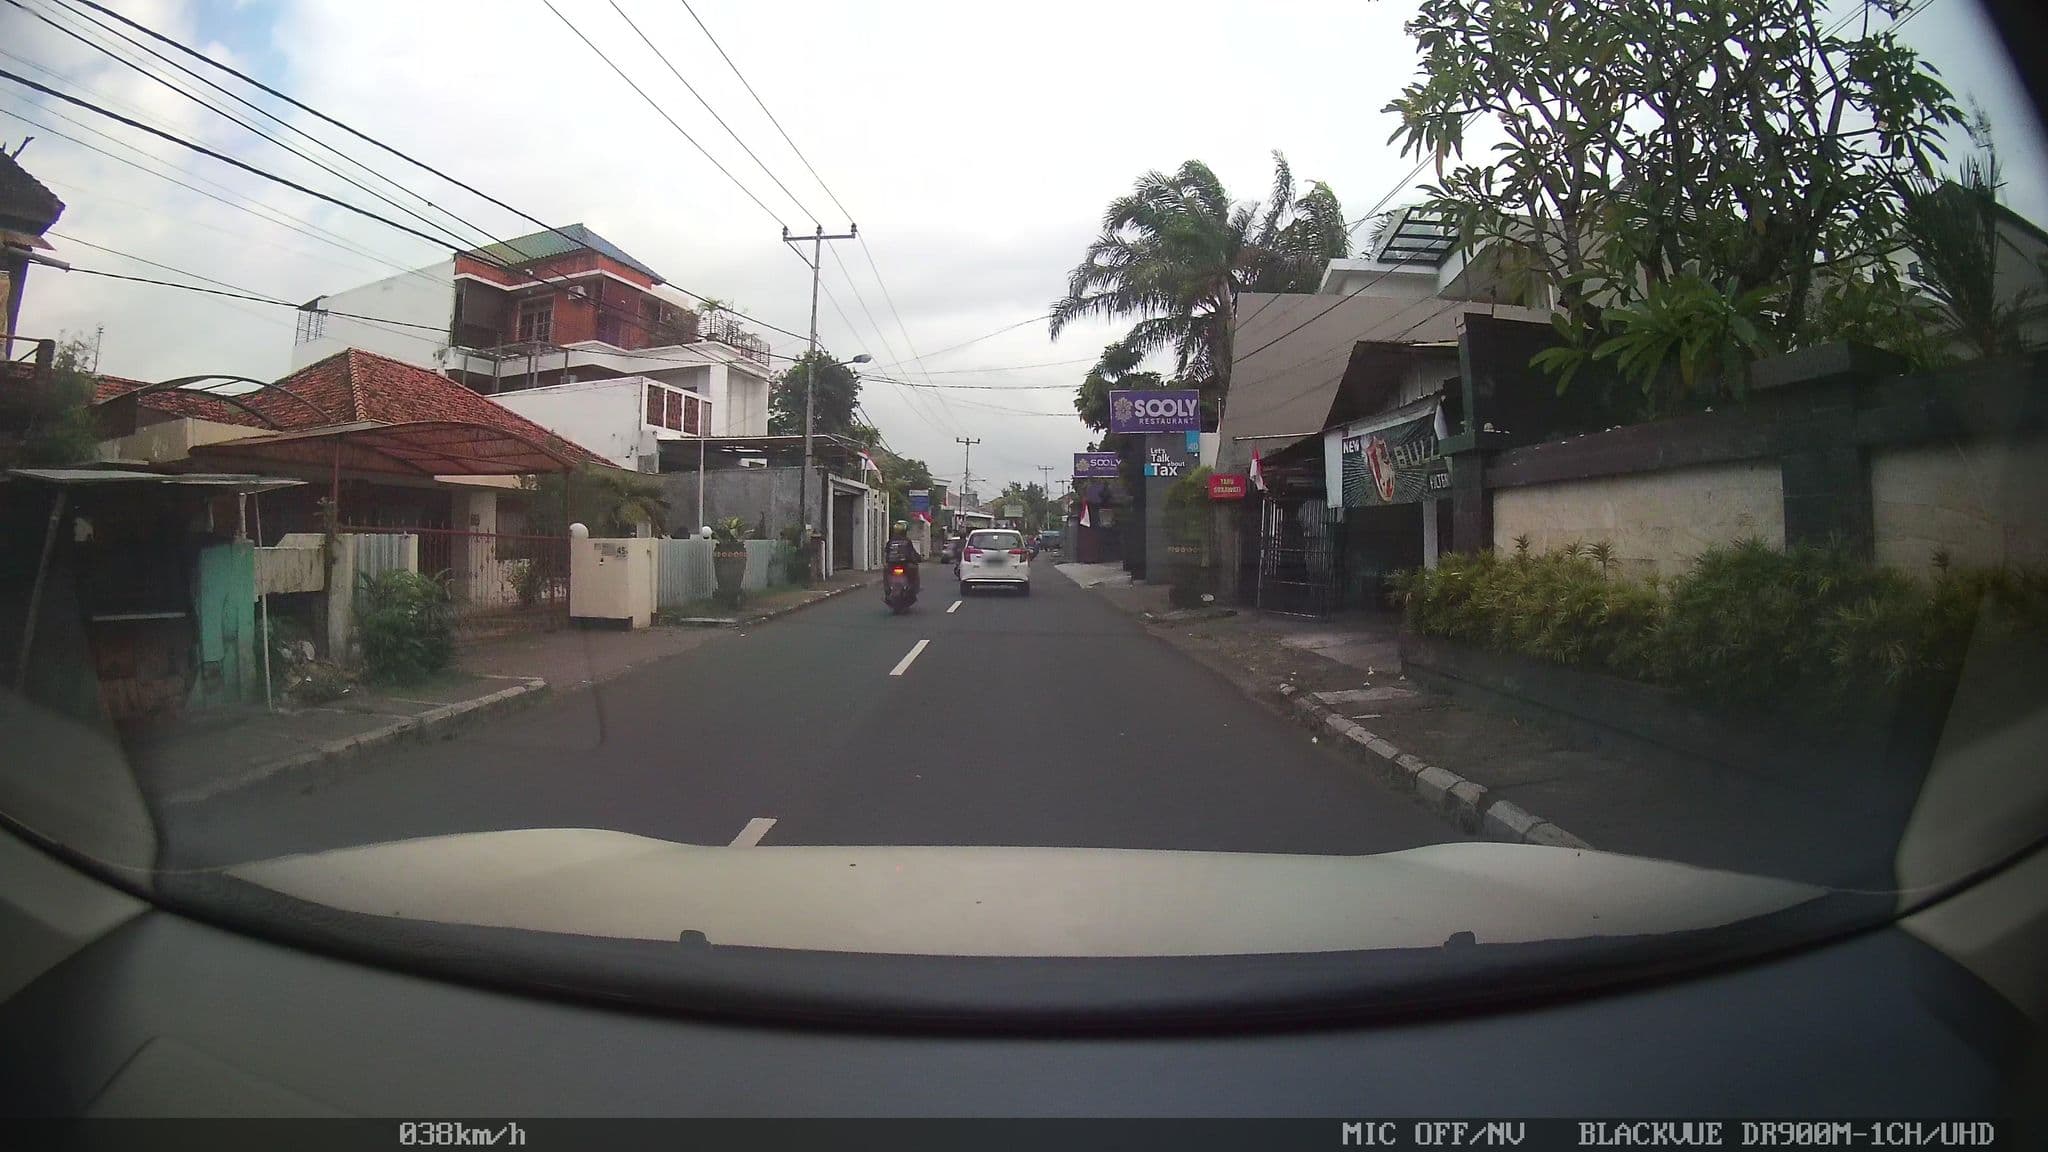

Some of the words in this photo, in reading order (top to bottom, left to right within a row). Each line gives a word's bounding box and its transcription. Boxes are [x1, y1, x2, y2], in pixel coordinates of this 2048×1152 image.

[1134, 398, 1197, 418] SOOLY
[1343, 440, 1360, 454] NEW
[1090, 459, 1122, 467] SOOLY
[1151, 453, 1170, 463] Talk
[1150, 463, 1178, 476] Tax
